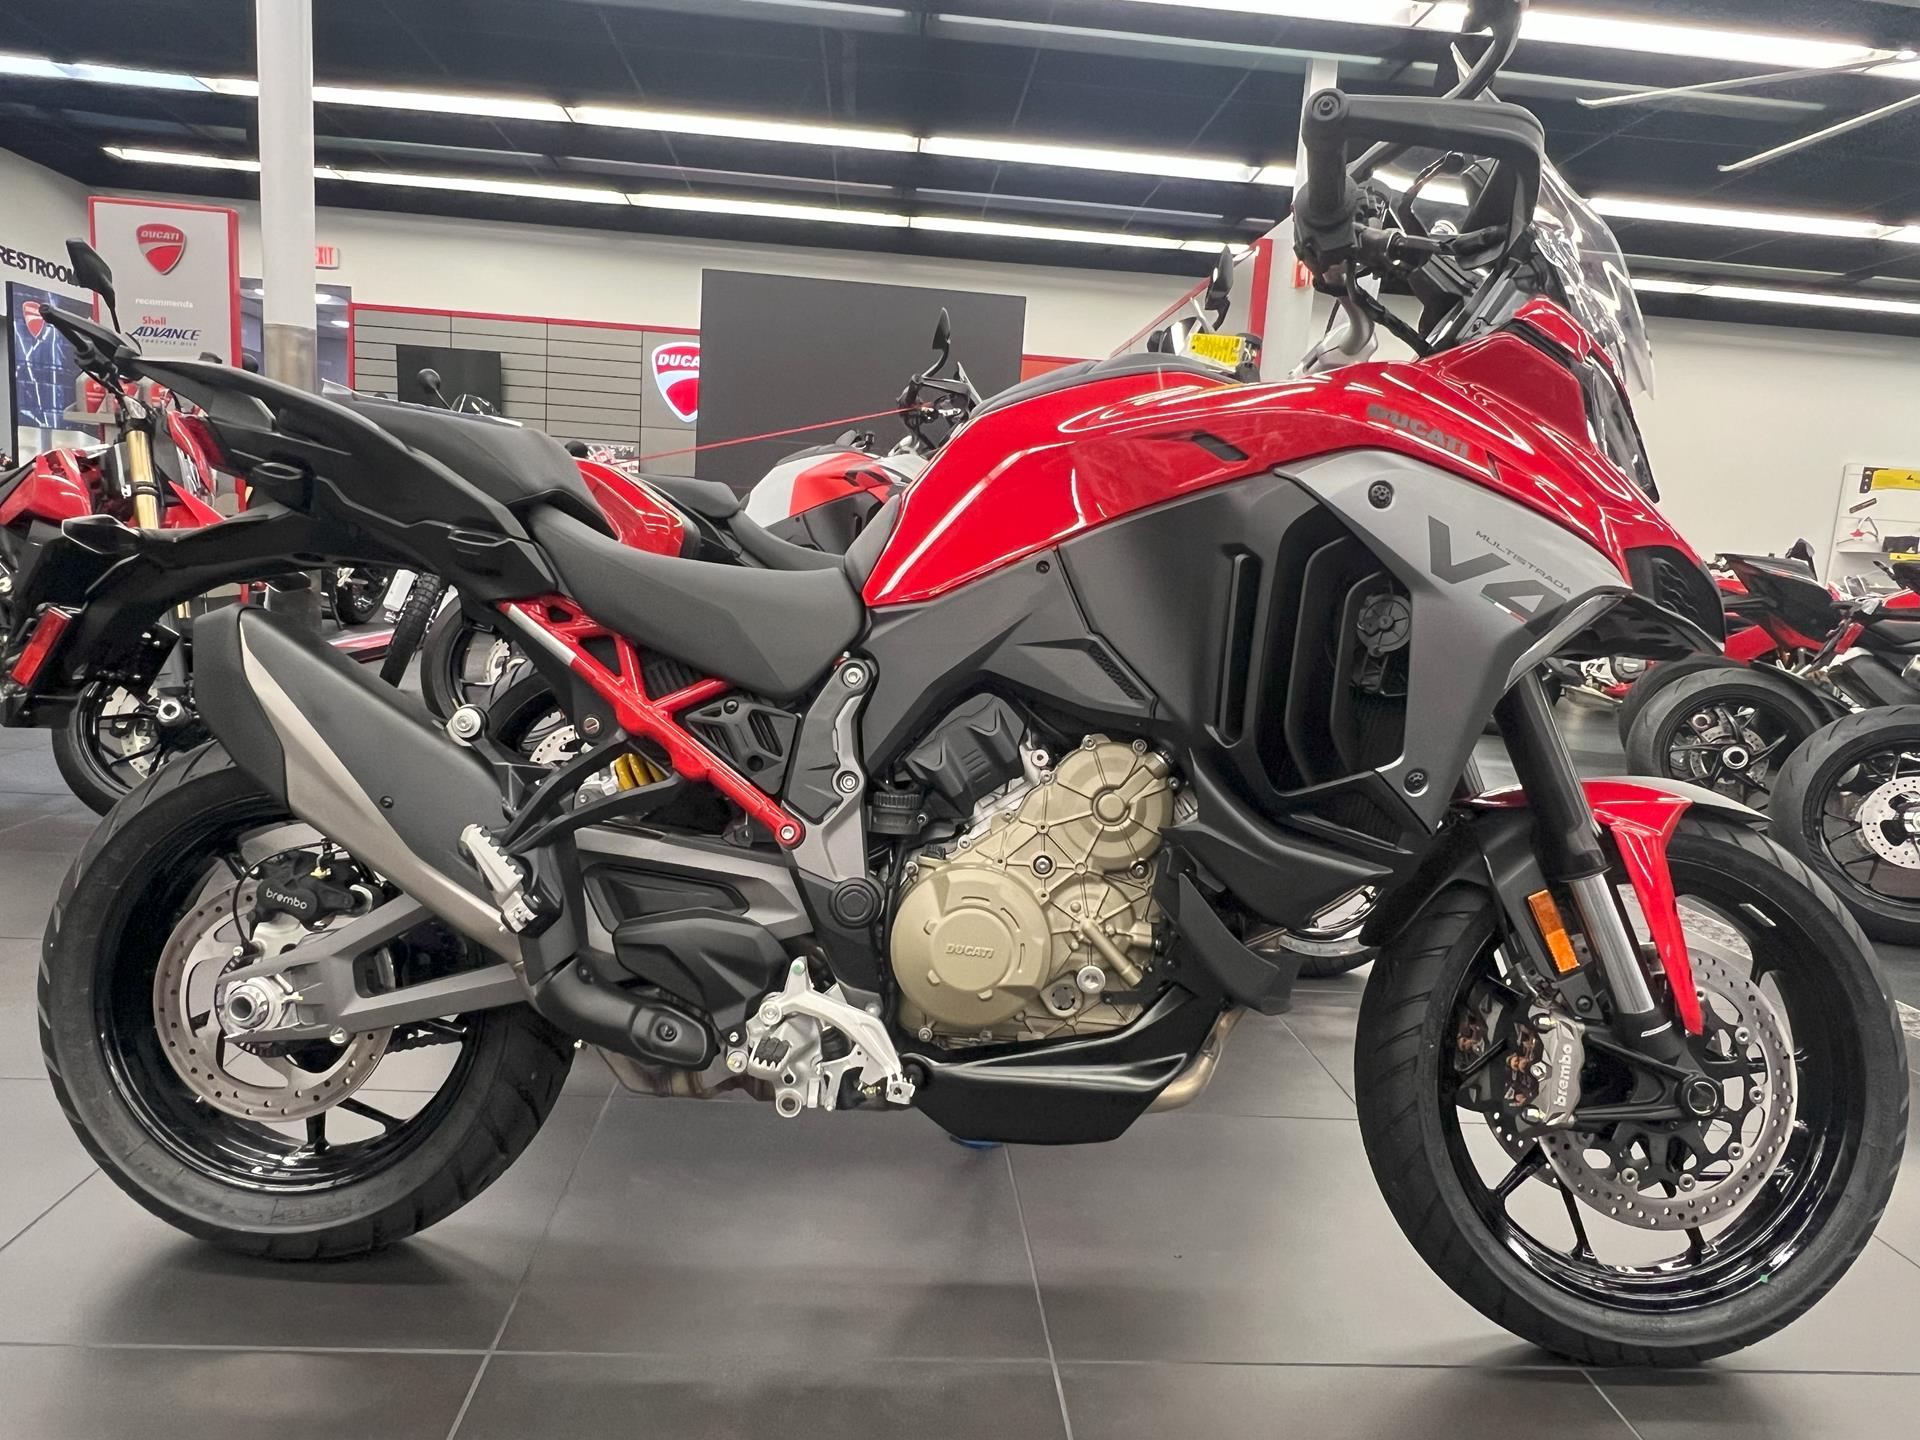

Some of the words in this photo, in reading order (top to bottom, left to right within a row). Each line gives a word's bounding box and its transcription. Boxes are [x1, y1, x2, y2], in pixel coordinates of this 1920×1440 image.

[141, 230, 180, 240] DUCATI
[142, 316, 167, 326] Shell
[131, 326, 202, 341] ADVANCE
[1367, 404, 1469, 459] DUCATI
[1475, 530, 1573, 595] MULTISTRADA
[265, 888, 308, 910] brembo
[944, 943, 995, 959] DUCATI
[1554, 1043, 1573, 1107] brembo
